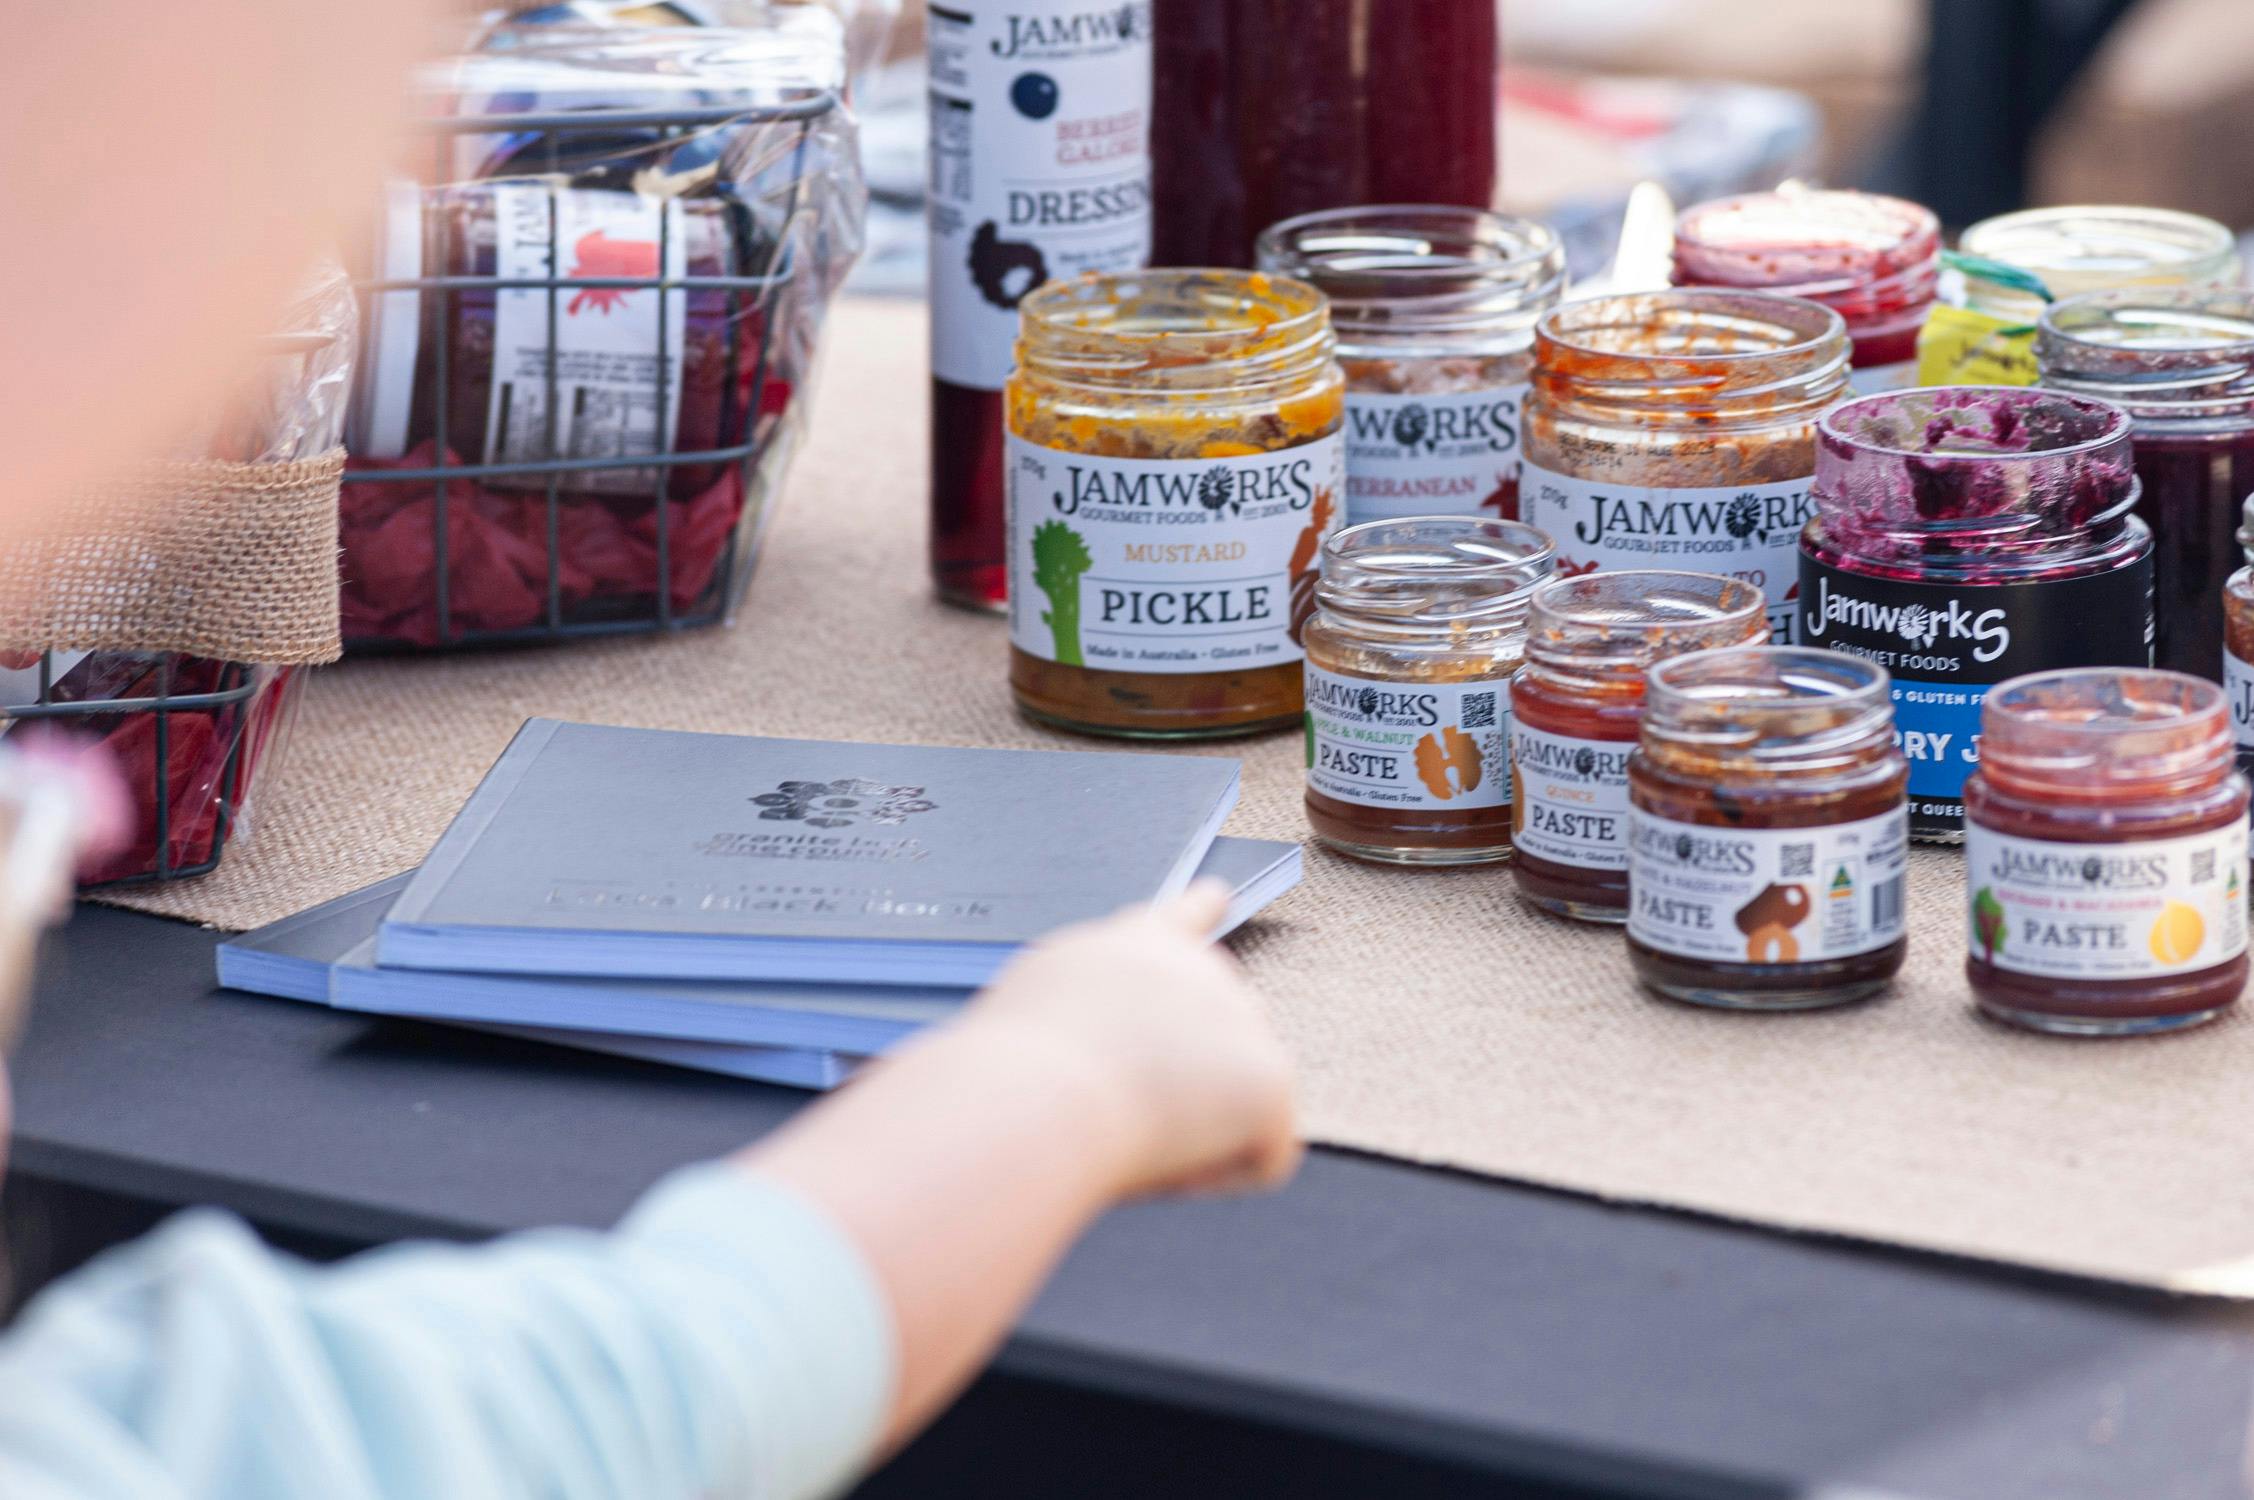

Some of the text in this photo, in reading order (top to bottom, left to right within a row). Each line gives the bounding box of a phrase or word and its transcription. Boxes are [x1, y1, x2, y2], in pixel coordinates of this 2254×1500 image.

[1053, 459, 1312, 516] JAMWORKS
[1080, 505, 1153, 525] GOURMET
[1157, 508, 1207, 525] FOODS
[1575, 492, 1812, 545] JAMWORK
[1124, 542, 1247, 563] MUSTARD
[1682, 538, 1735, 554] FOODS
[1101, 586, 1271, 625] PICKLE
[1807, 577, 2010, 663] Jamworks
[1087, 642, 1280, 660] Made in Australia Gluten Free
[1829, 640, 1961, 672] GOURMET FOODS
[1306, 673, 1438, 727] JAMWORKS
[1905, 690, 1967, 705] GLUTEN
[1353, 728, 1414, 746] WALNUT
[1320, 743, 1399, 780] PASTE
[1368, 790, 1399, 801] Gluten
[1401, 793, 1423, 802] Free
[1545, 784, 1595, 803] QUINCE
[1532, 804, 1616, 841] PASTE
[1992, 848, 2168, 887] JAMWORKS
[2024, 917, 2127, 949] PASTE
